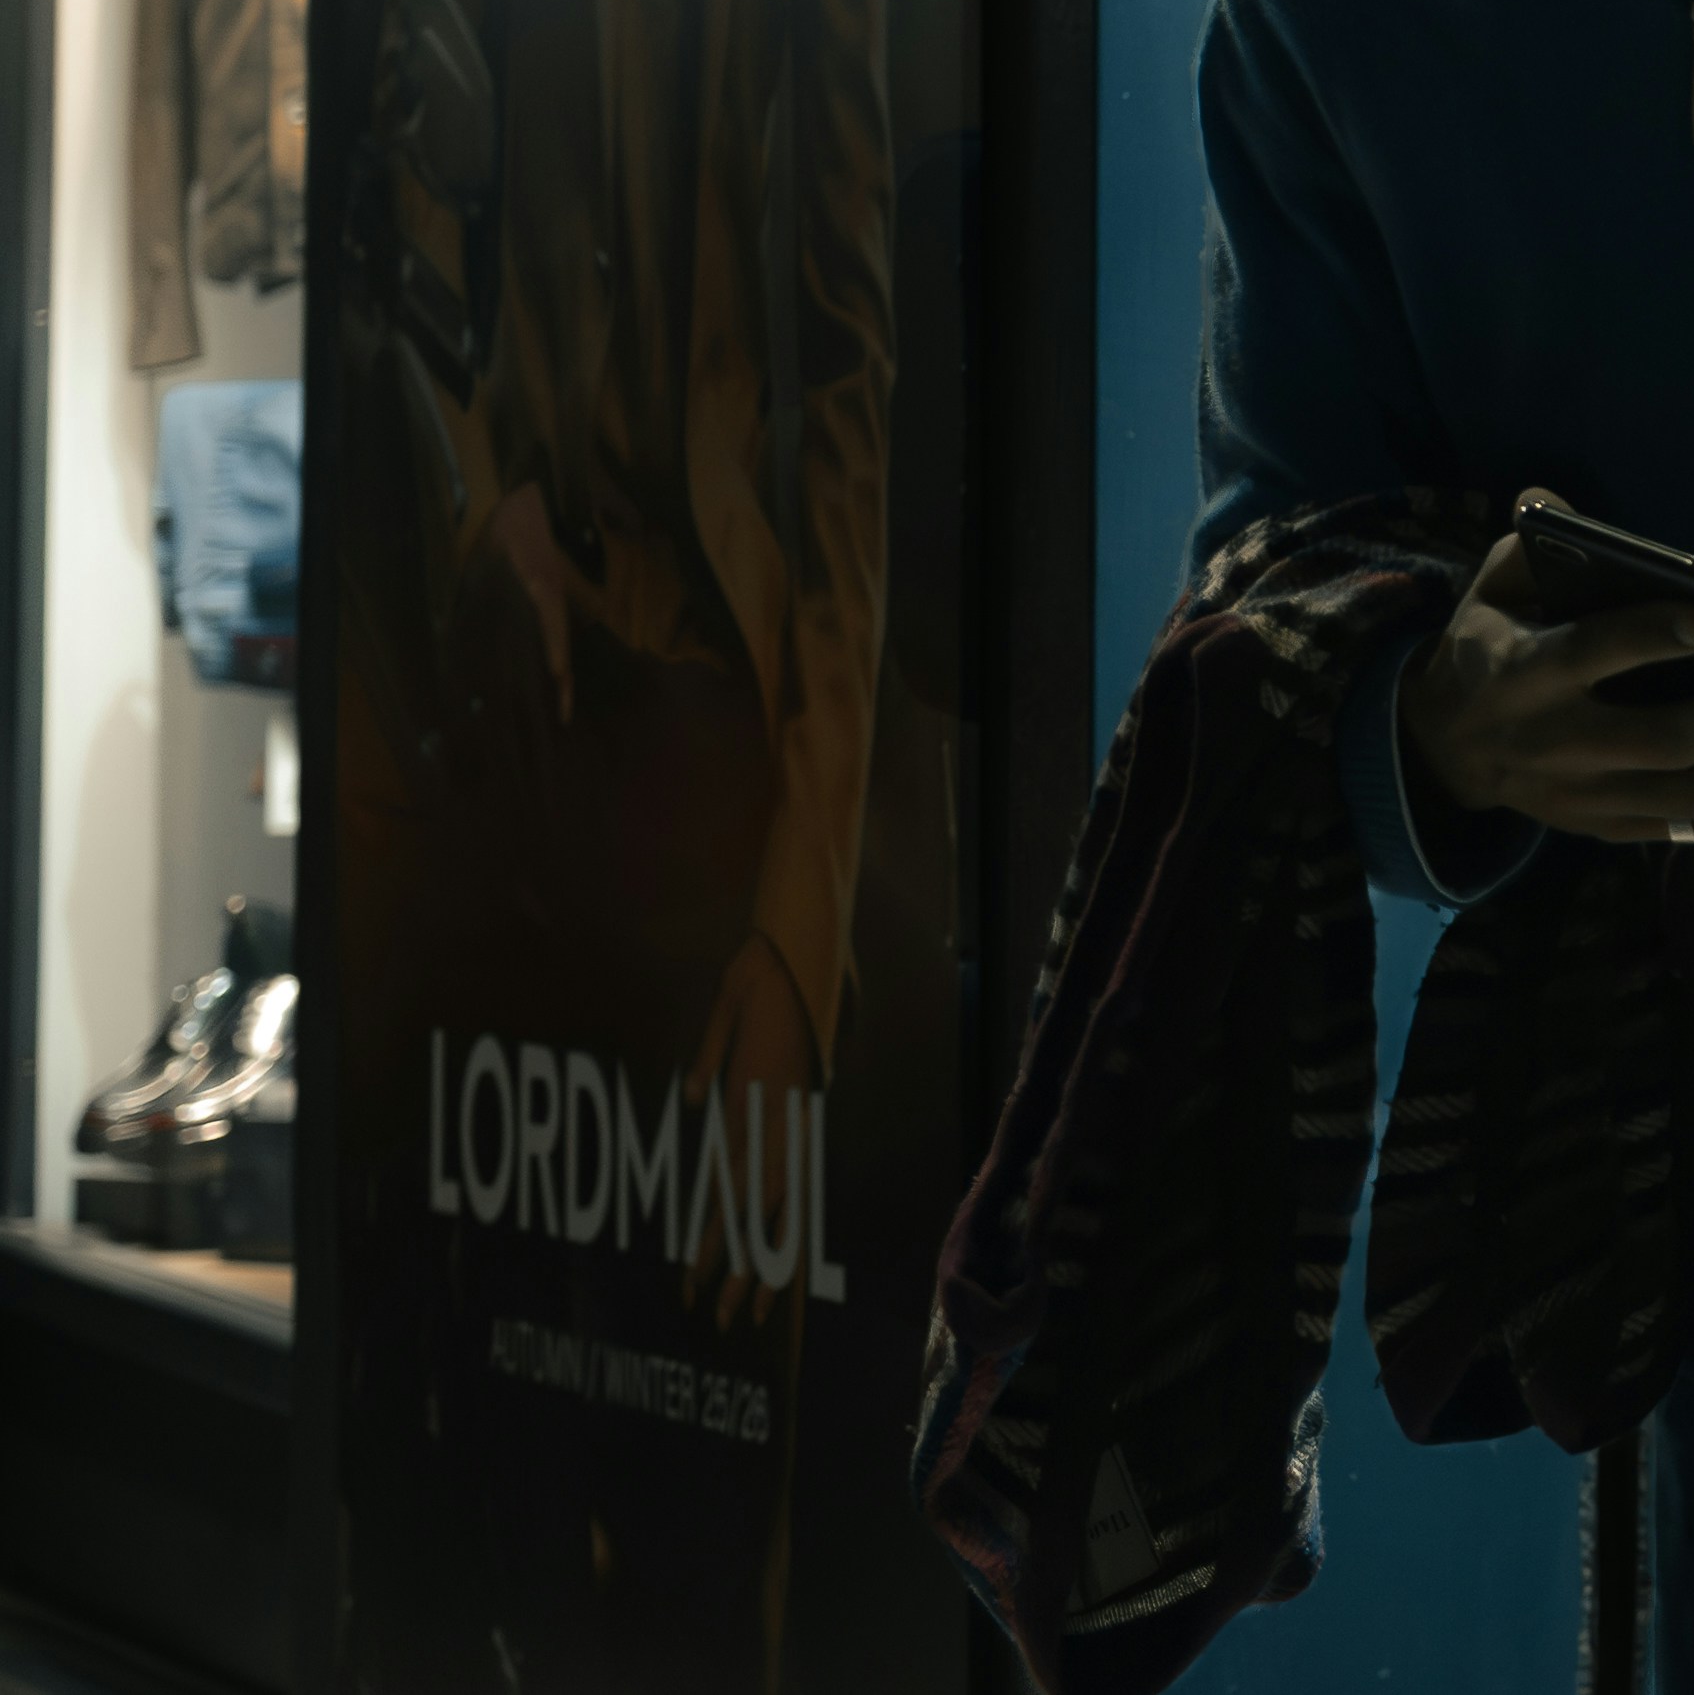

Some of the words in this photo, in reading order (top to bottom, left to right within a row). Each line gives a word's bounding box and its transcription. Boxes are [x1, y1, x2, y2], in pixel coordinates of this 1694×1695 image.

[429, 1027, 846, 1304] LORDMAUL
[490, 1317, 584, 1393] AUTUMN
[603, 1343, 697, 1424] WINTER
[701, 1371, 770, 1445] 25/26
